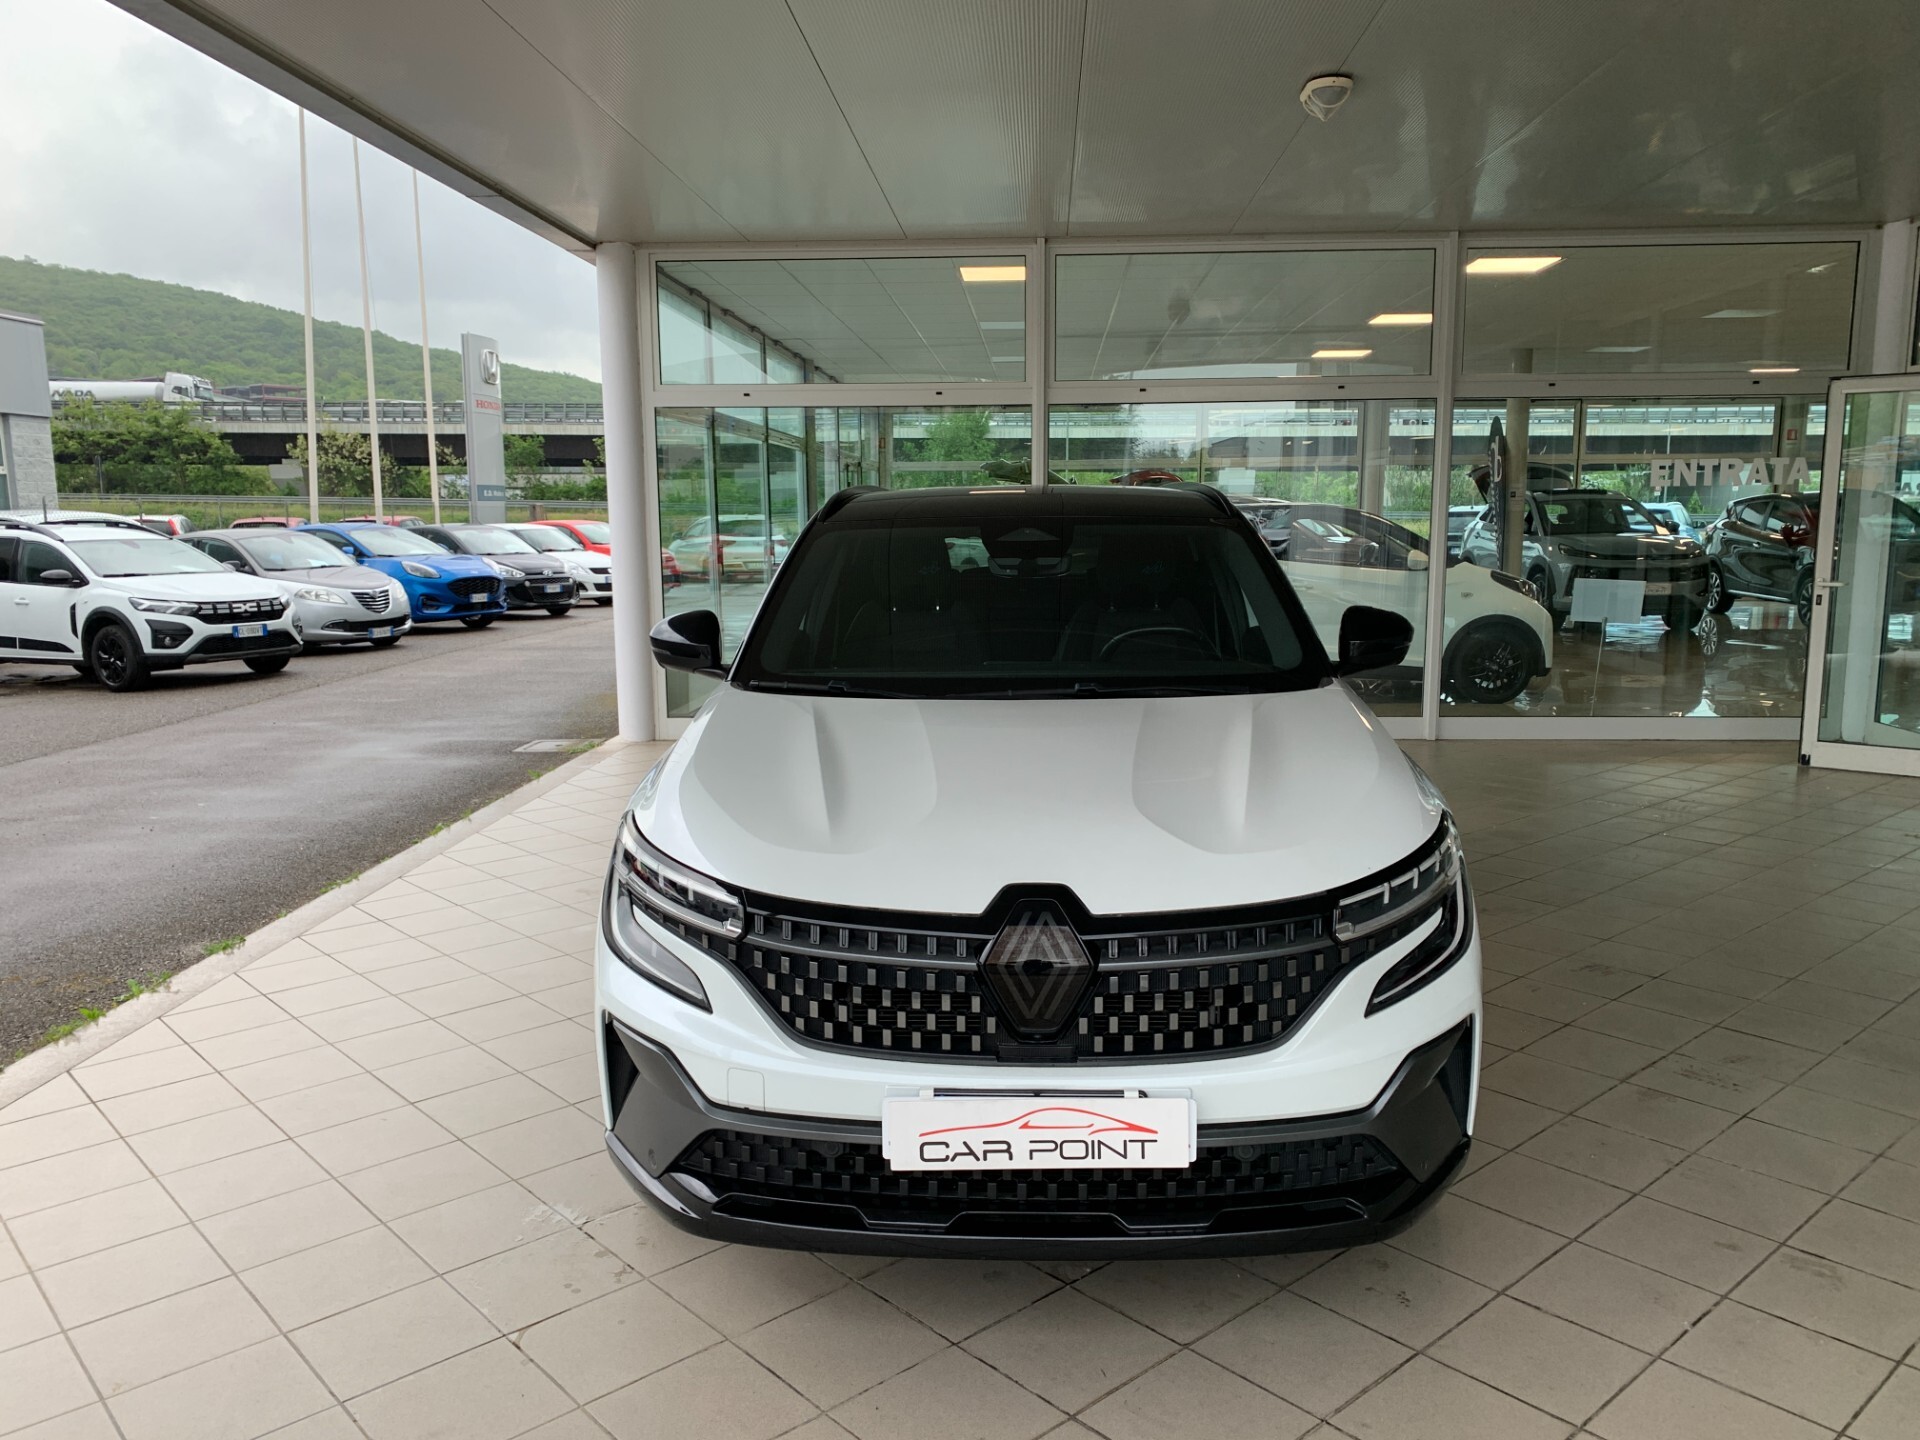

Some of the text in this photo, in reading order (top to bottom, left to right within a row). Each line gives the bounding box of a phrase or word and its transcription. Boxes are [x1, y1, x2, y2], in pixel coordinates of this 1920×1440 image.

[1651, 457, 1811, 487] ENTRATA
[919, 1139, 1158, 1163] CAR POINT
